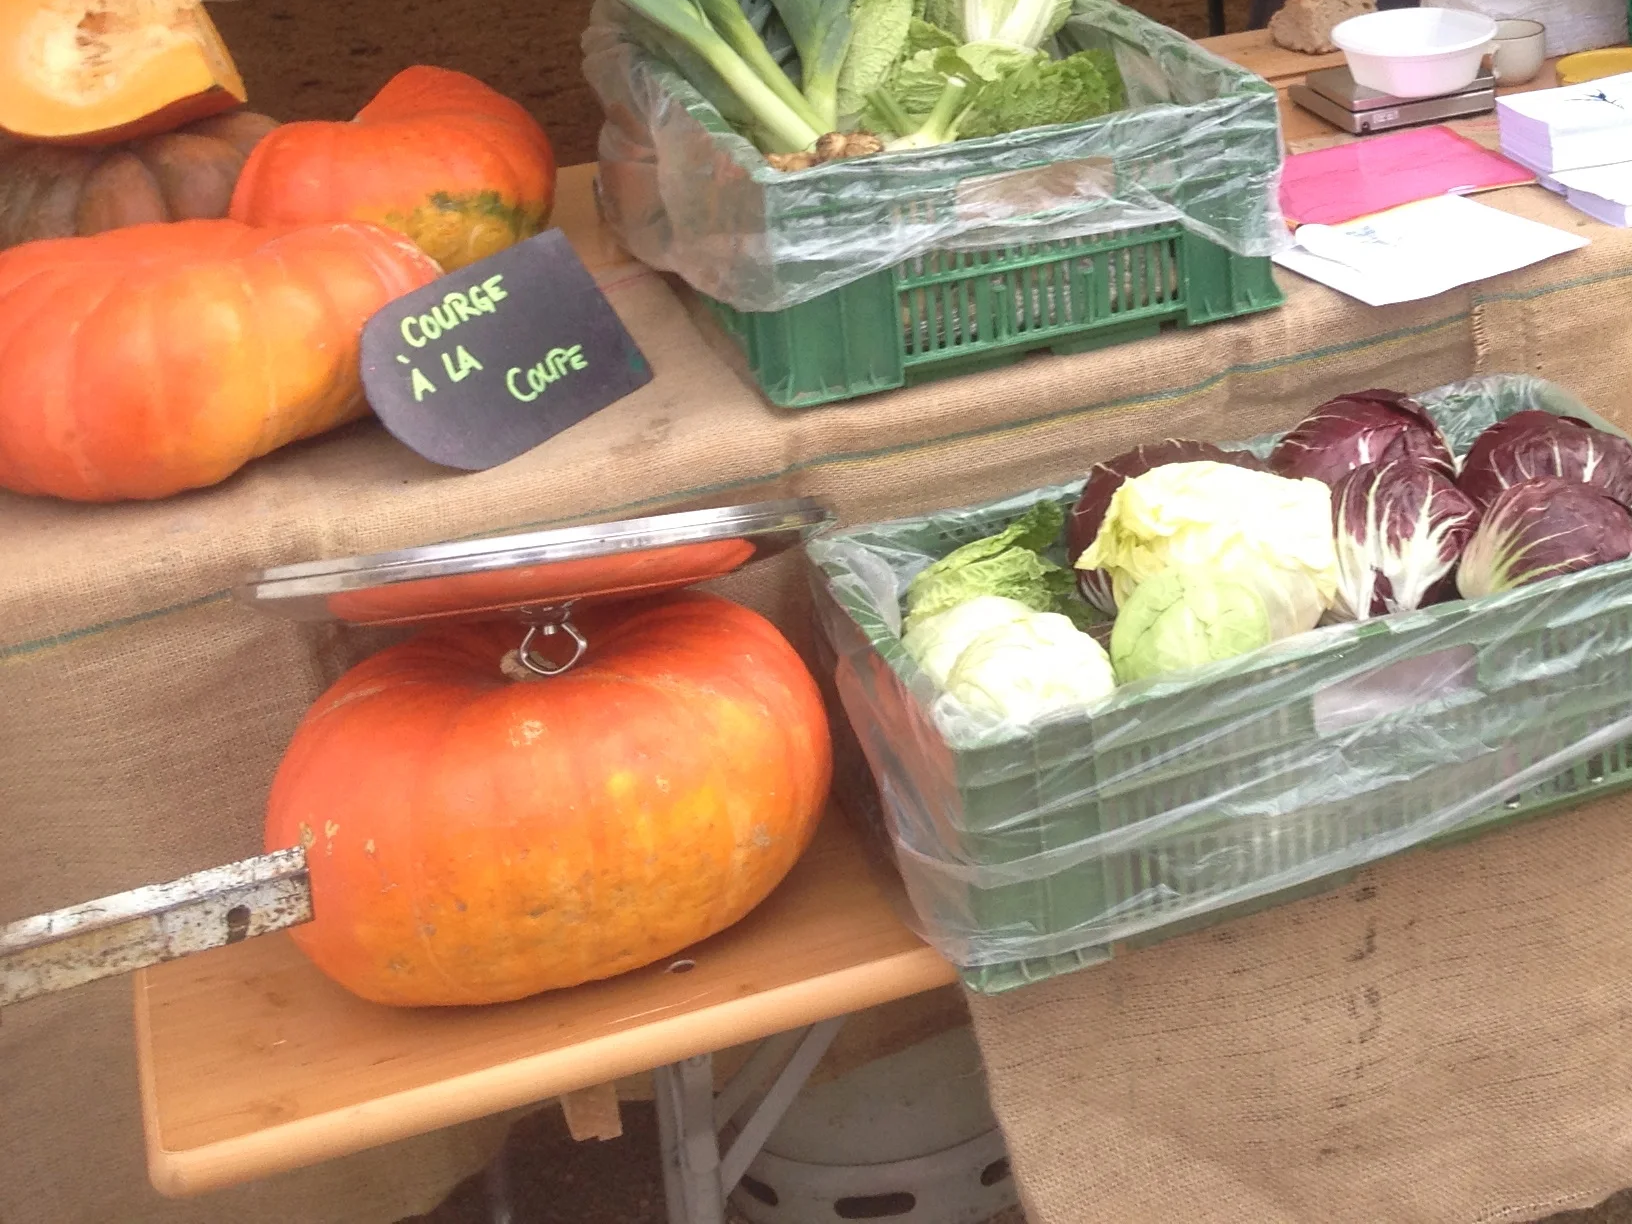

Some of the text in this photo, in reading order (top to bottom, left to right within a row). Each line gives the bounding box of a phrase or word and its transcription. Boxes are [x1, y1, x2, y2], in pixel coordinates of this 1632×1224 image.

[401, 274, 508, 347] COURGE
[396, 345, 484, 402] À LA
[506, 344, 588, 402] COUPE
